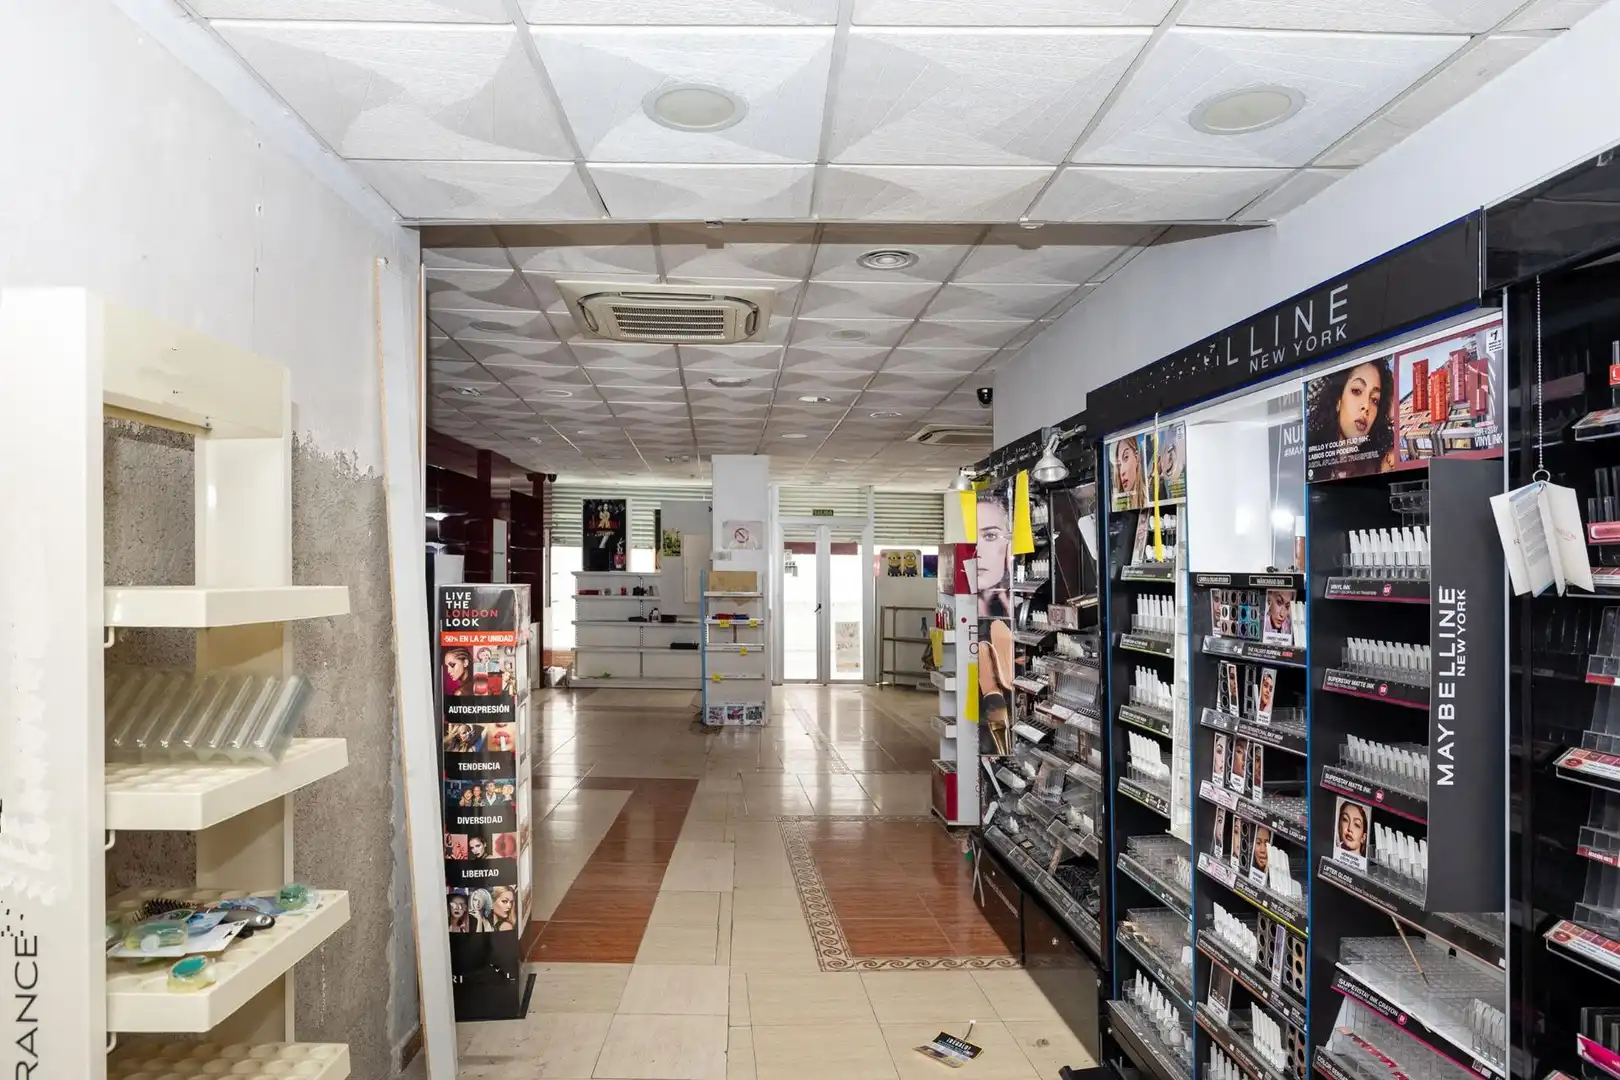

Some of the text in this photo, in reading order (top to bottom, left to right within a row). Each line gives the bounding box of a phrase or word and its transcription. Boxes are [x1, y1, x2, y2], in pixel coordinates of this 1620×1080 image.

[1250, 323, 1347, 374] NEW YORK
[445, 592, 472, 600] LIVE
[446, 600, 470, 609] THE
[446, 610, 498, 618] LONDON
[446, 618, 480, 626] LOOK
[1457, 589, 1466, 676] NEW YORK
[1437, 586, 1456, 786] MAYBELLINE
[448, 704, 510, 714] AUTOEXPRESIÓN
[458, 762, 501, 771] TENDENCIA
[457, 815, 503, 825] DIVERSIDAD
[462, 868, 500, 878] LIBERTAD
